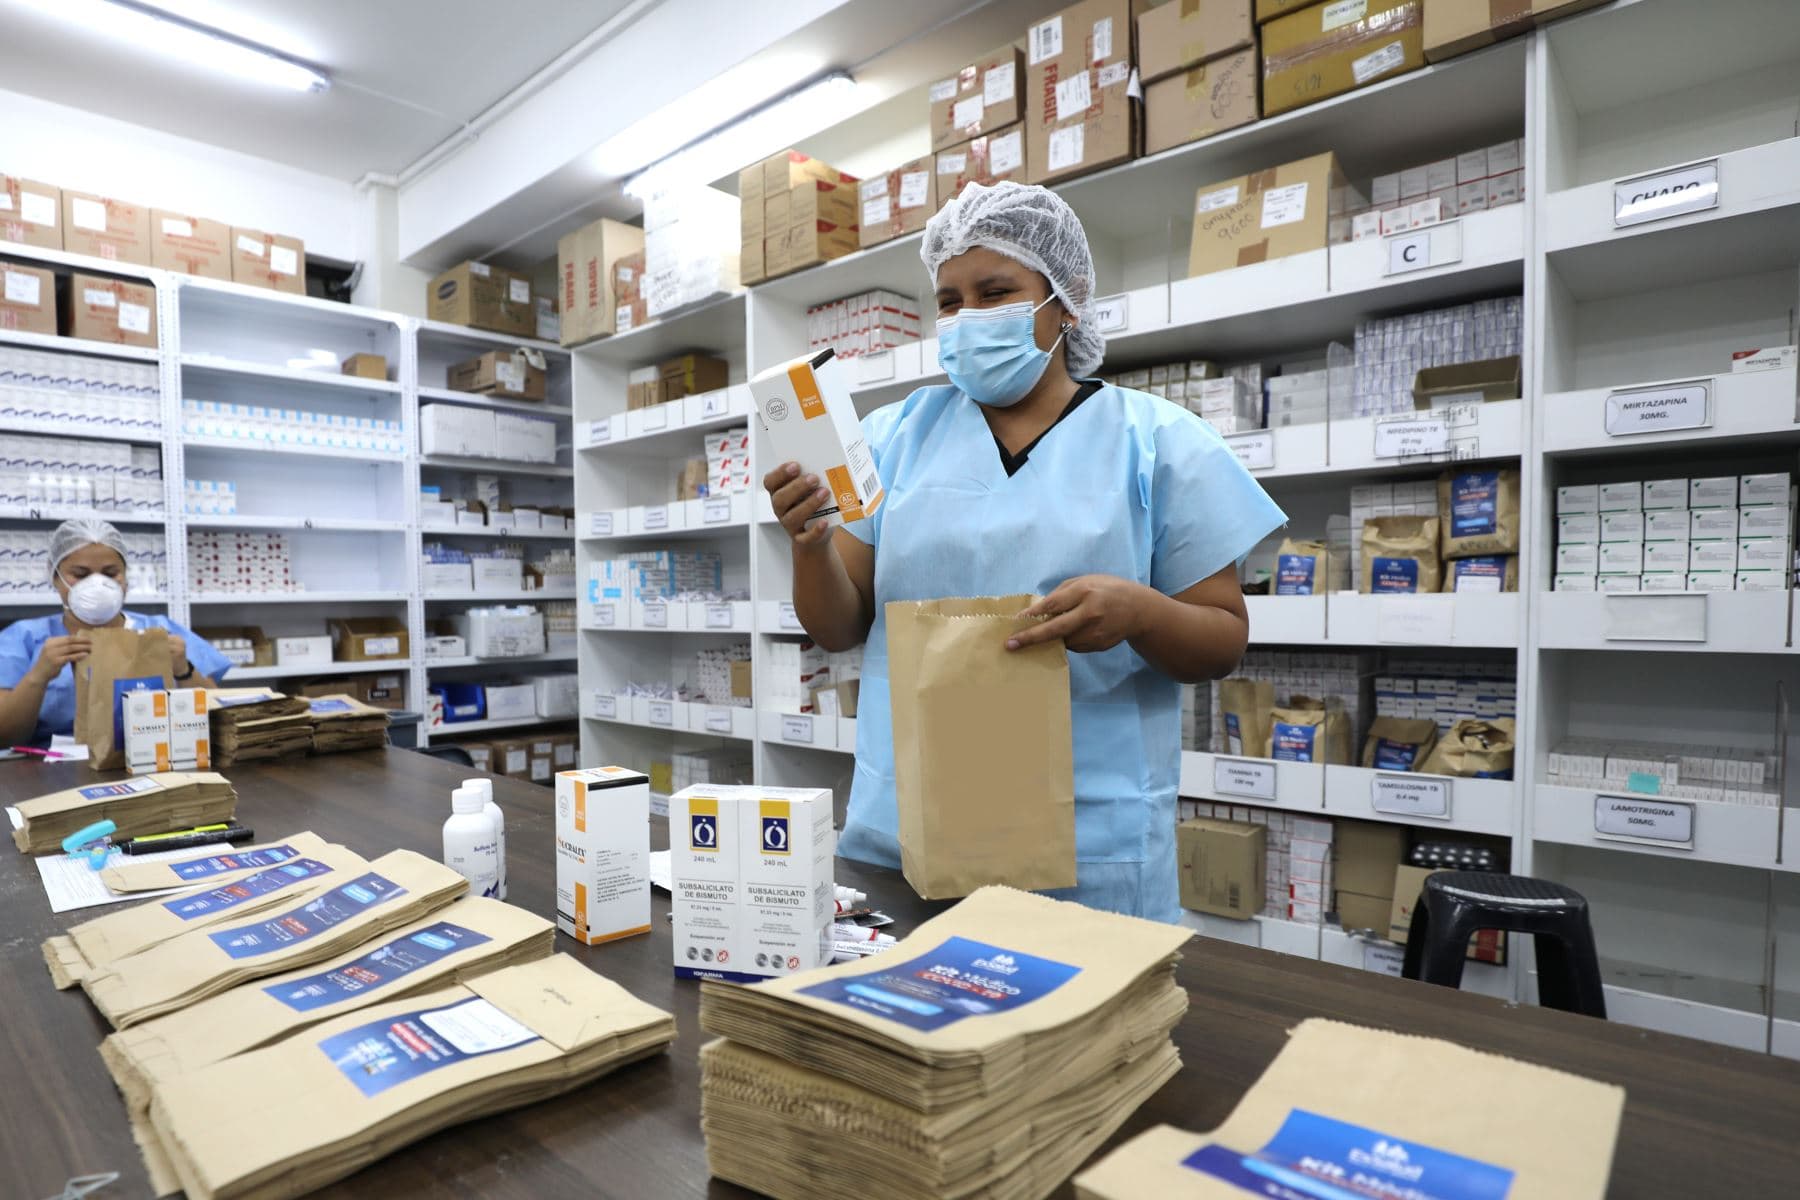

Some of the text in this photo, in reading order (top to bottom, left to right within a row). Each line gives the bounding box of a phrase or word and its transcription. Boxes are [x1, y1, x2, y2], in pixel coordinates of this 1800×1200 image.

[1044, 62, 1058, 124] FRAGIL
[1403, 245, 1417, 262] C
[565, 262, 575, 312] FRAGIL
[588, 256, 598, 309] FRAGIL
[706, 400, 714, 411] A
[1622, 397, 1688, 410] MIRTAZAPINA
[1377, 782, 1428, 791] TAMSULOSINA
[1610, 804, 1676, 817] LAMOTRIGINA
[693, 855, 717, 864] 240 mL
[763, 859, 776, 867] 240
[678, 882, 734, 893] SUBSALICILATO
[748, 887, 806, 898] SUBSALICILATO
[684, 891, 728, 901] DE BISMUTO
[754, 896, 800, 906] DE BISMUTO
